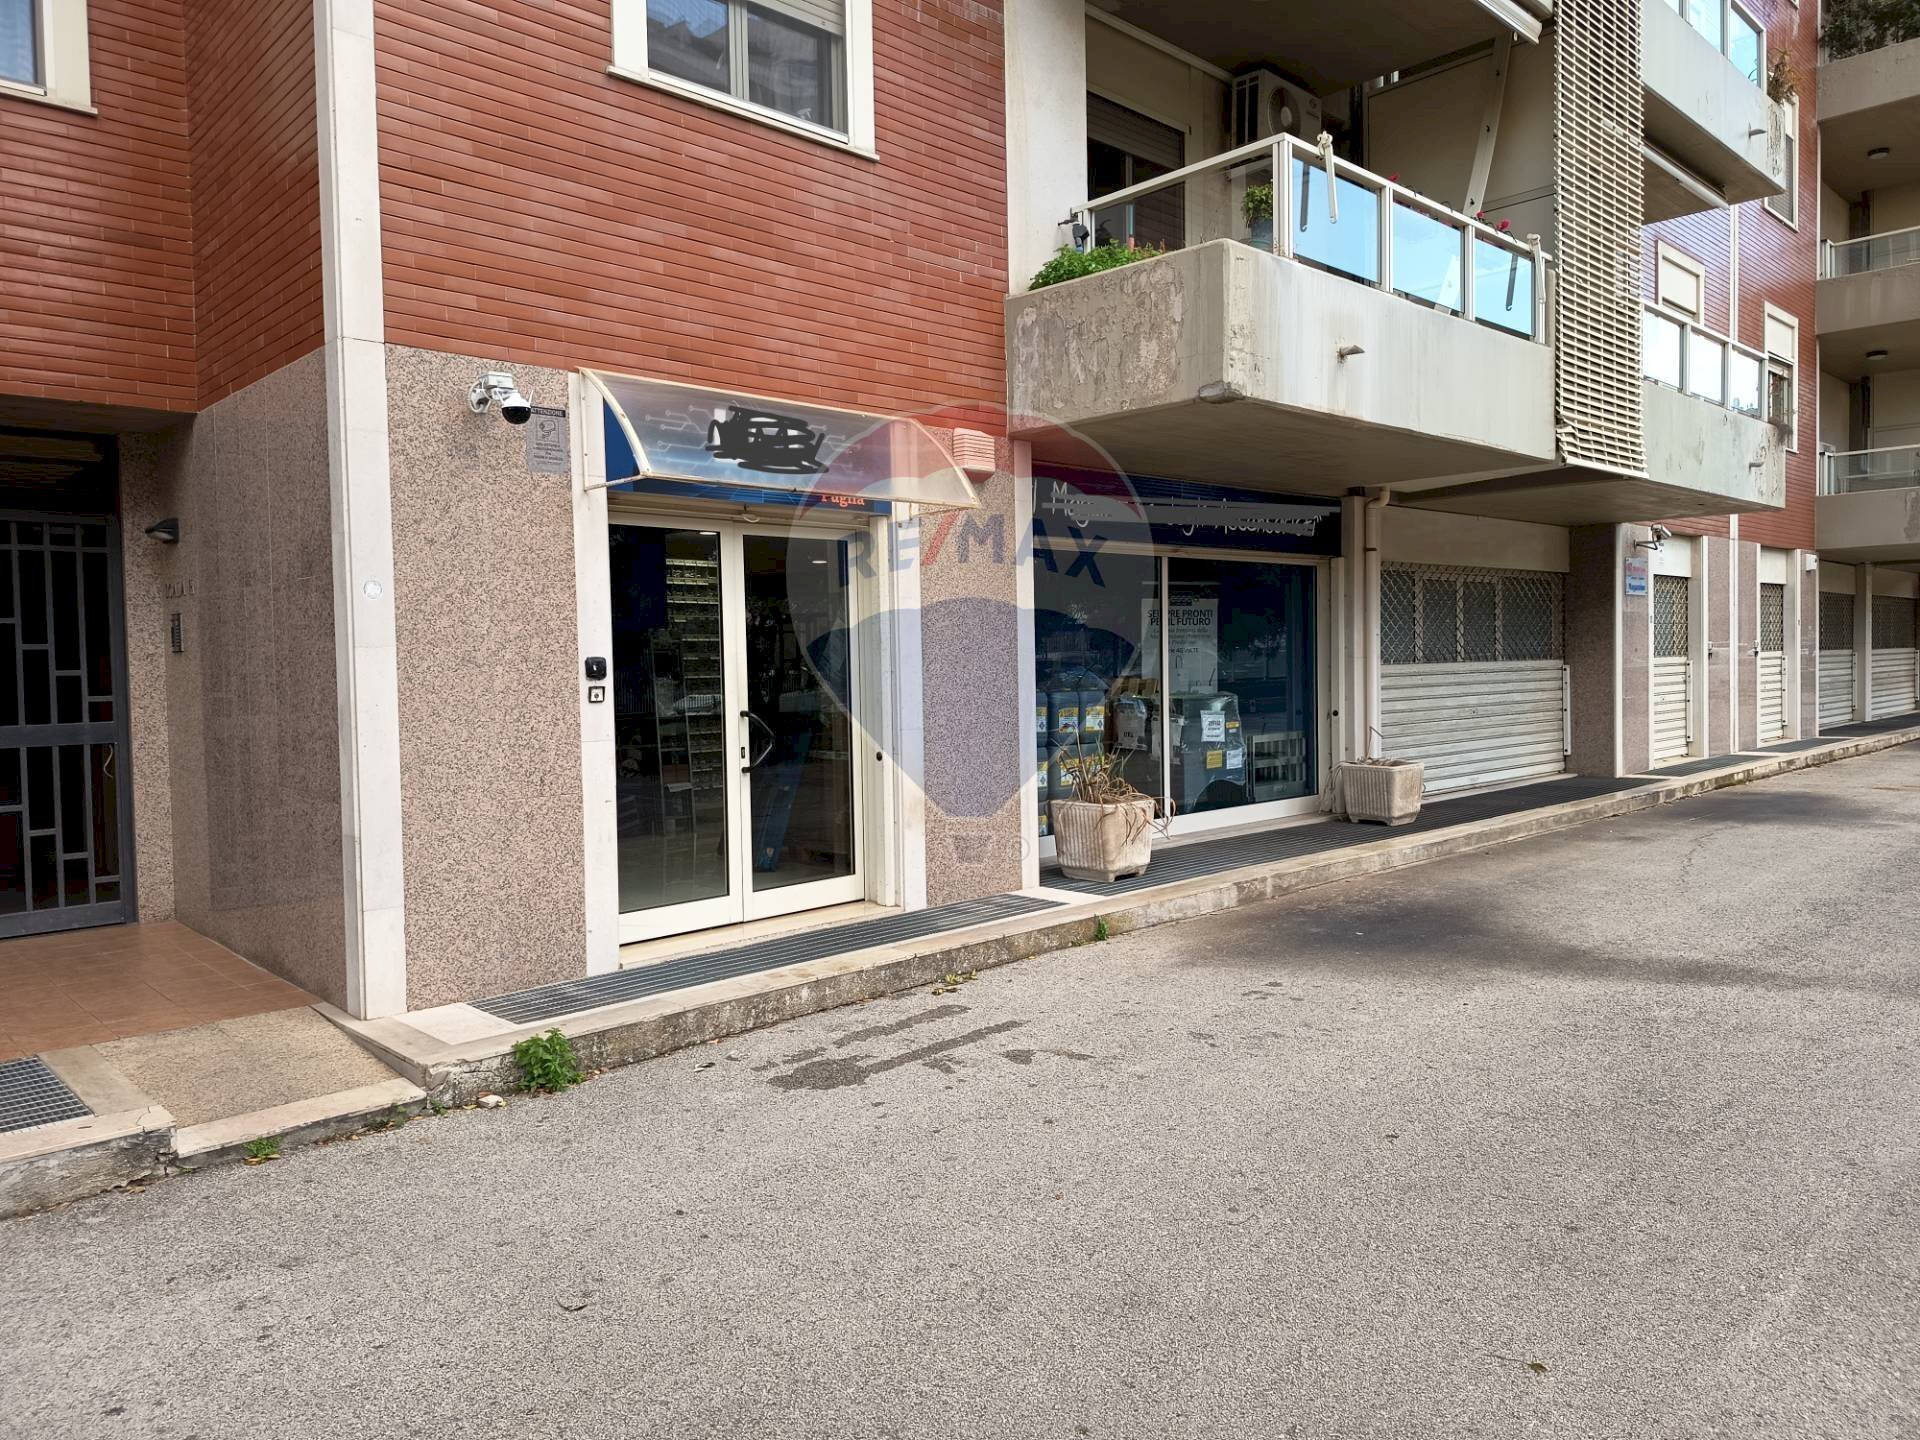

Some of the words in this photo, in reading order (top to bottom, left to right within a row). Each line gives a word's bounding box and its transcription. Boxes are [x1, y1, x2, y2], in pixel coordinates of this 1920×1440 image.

[1147, 609, 1181, 618] SEPRE
[1182, 609, 1213, 618] PRONTI
[1176, 617, 1211, 626] FUTURO
